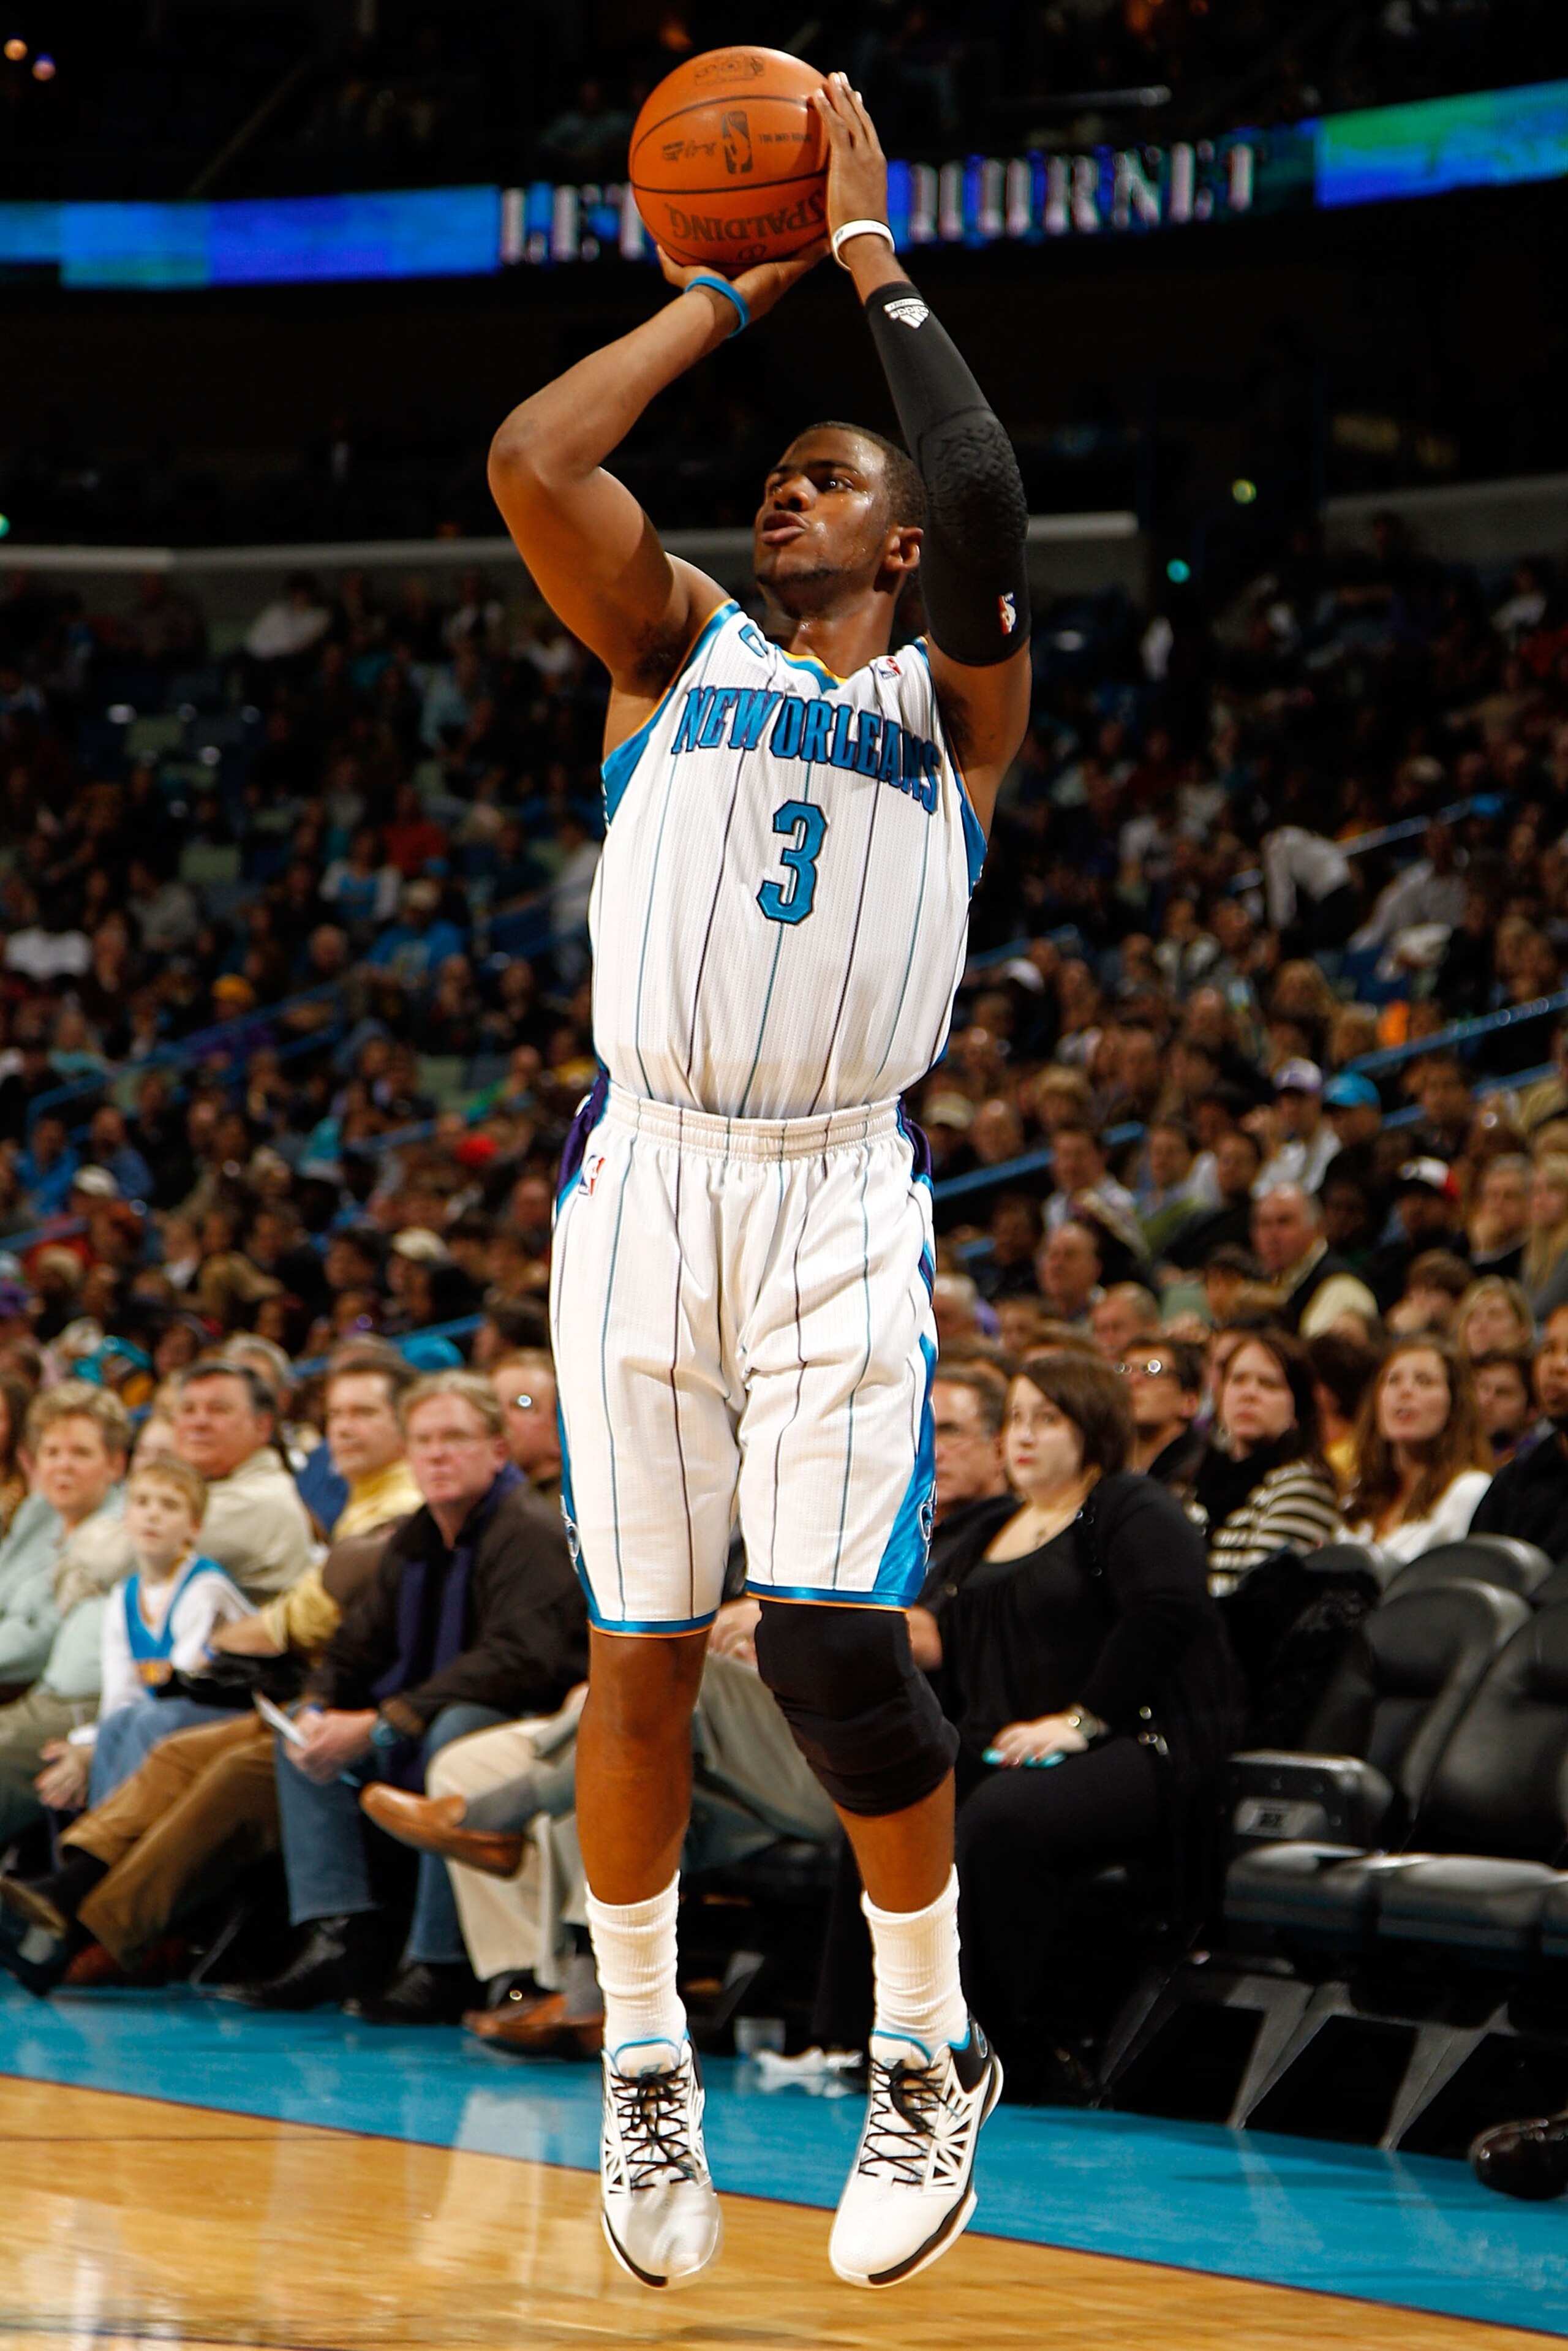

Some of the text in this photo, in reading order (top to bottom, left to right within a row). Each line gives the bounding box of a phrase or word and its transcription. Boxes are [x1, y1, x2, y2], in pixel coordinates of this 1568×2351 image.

[664, 191, 825, 241] SPALDING
[671, 686, 941, 814] NEW ORLEANS
[756, 799, 827, 926] 3
